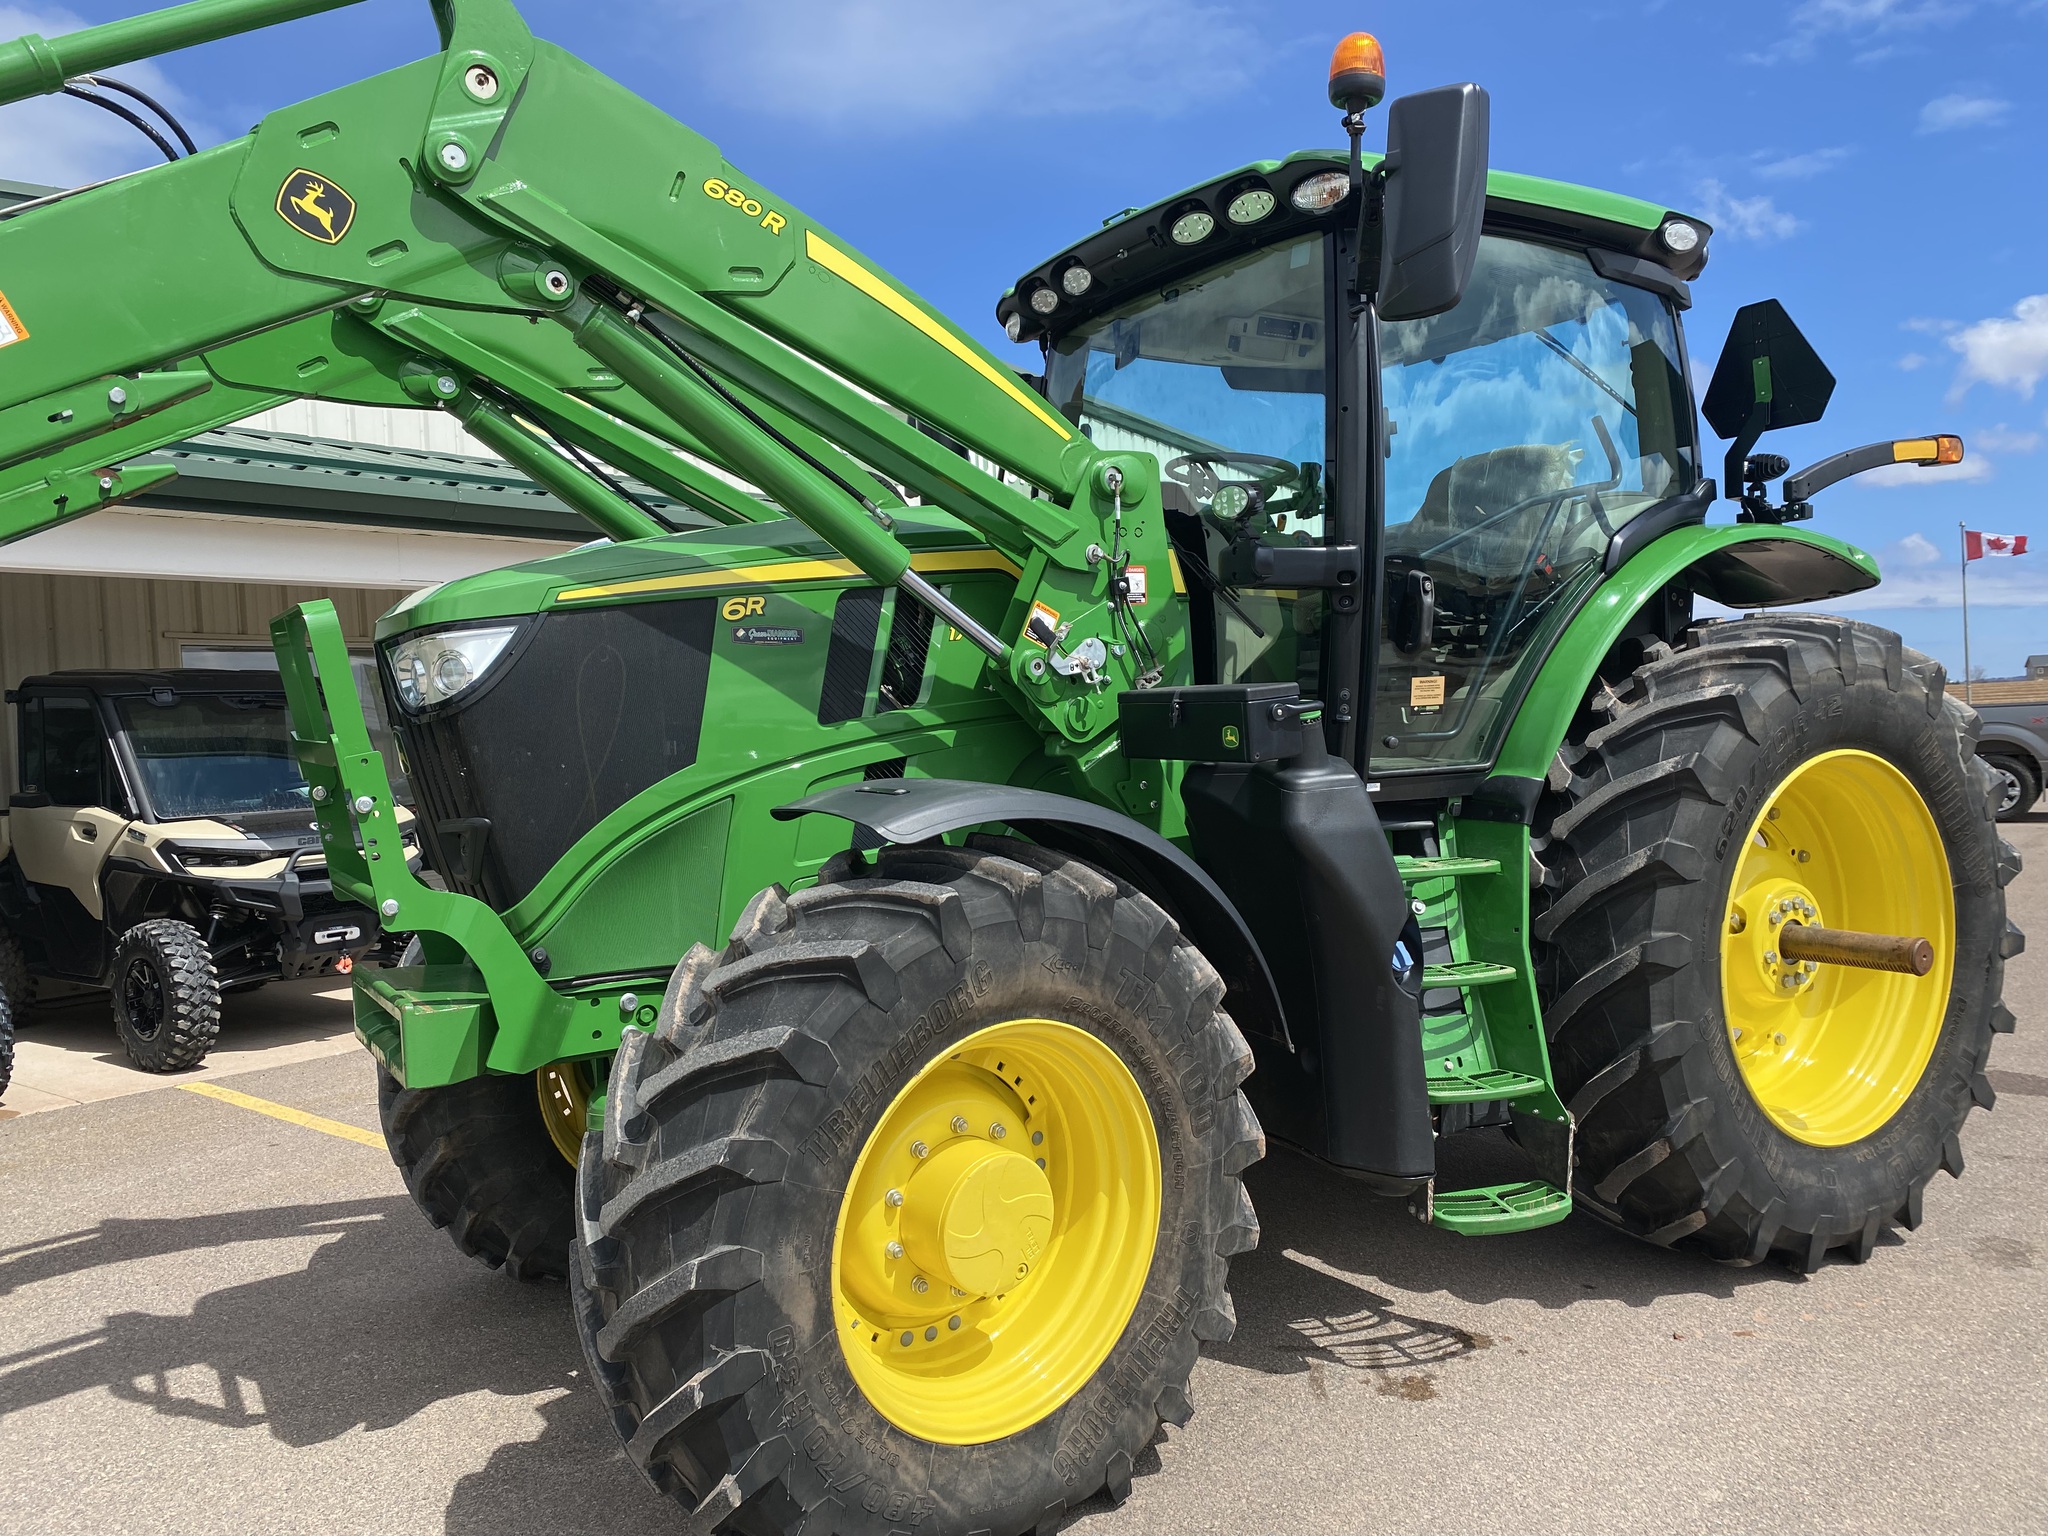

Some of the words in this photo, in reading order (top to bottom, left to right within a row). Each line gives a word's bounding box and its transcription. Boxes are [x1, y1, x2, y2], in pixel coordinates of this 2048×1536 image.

[702, 177, 763, 217] 680
[759, 209, 787, 237] R
[1, 303, 23, 334] WARNING
[722, 596, 766, 621] 6R
[1905, 722, 1993, 899] TRELLEBORG
[797, 959, 995, 1168] TRELLEBORG
[1052, 1285, 1199, 1488] TRELLEBORG
